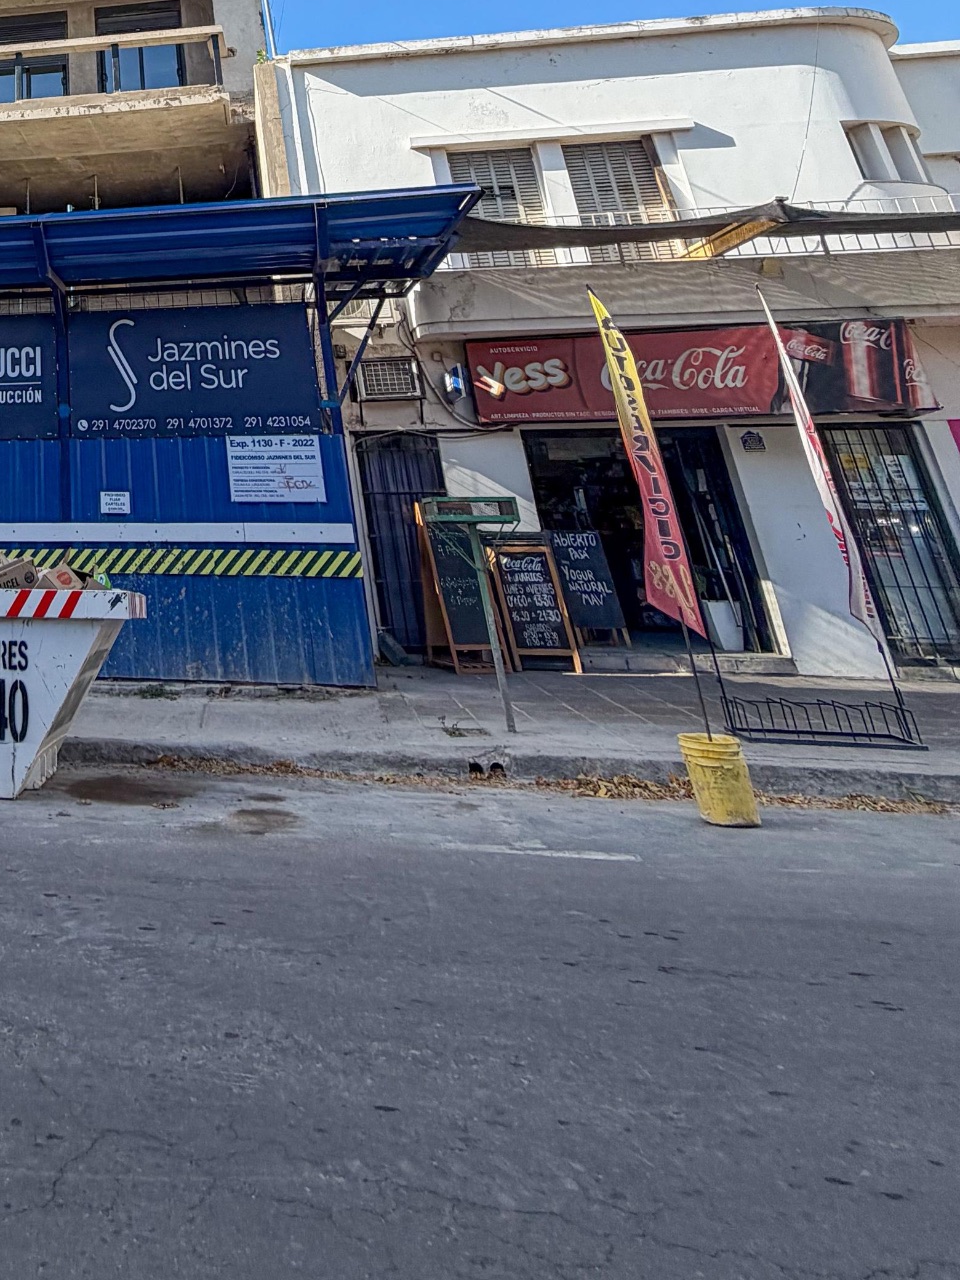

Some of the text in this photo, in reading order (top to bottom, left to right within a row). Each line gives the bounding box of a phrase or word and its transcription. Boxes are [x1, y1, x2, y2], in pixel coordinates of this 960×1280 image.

[147, 334, 280, 362] Jazmines
[489, 346, 538, 354] AUTOSERVICIO
[600, 345, 749, 391] Cca-Cola
[149, 363, 248, 390] del Sur
[91, 419, 157, 430] 291 4702370
[166, 417, 233, 429] 291 4701372
[244, 416, 311, 428] 291 4231054
[230, 440, 249, 449] Exp.
[251, 439, 272, 448] 1130
[292, 439, 315, 447] 2022
[561, 565, 595, 581] YOGUR
[568, 581, 612, 593] NATURAL
